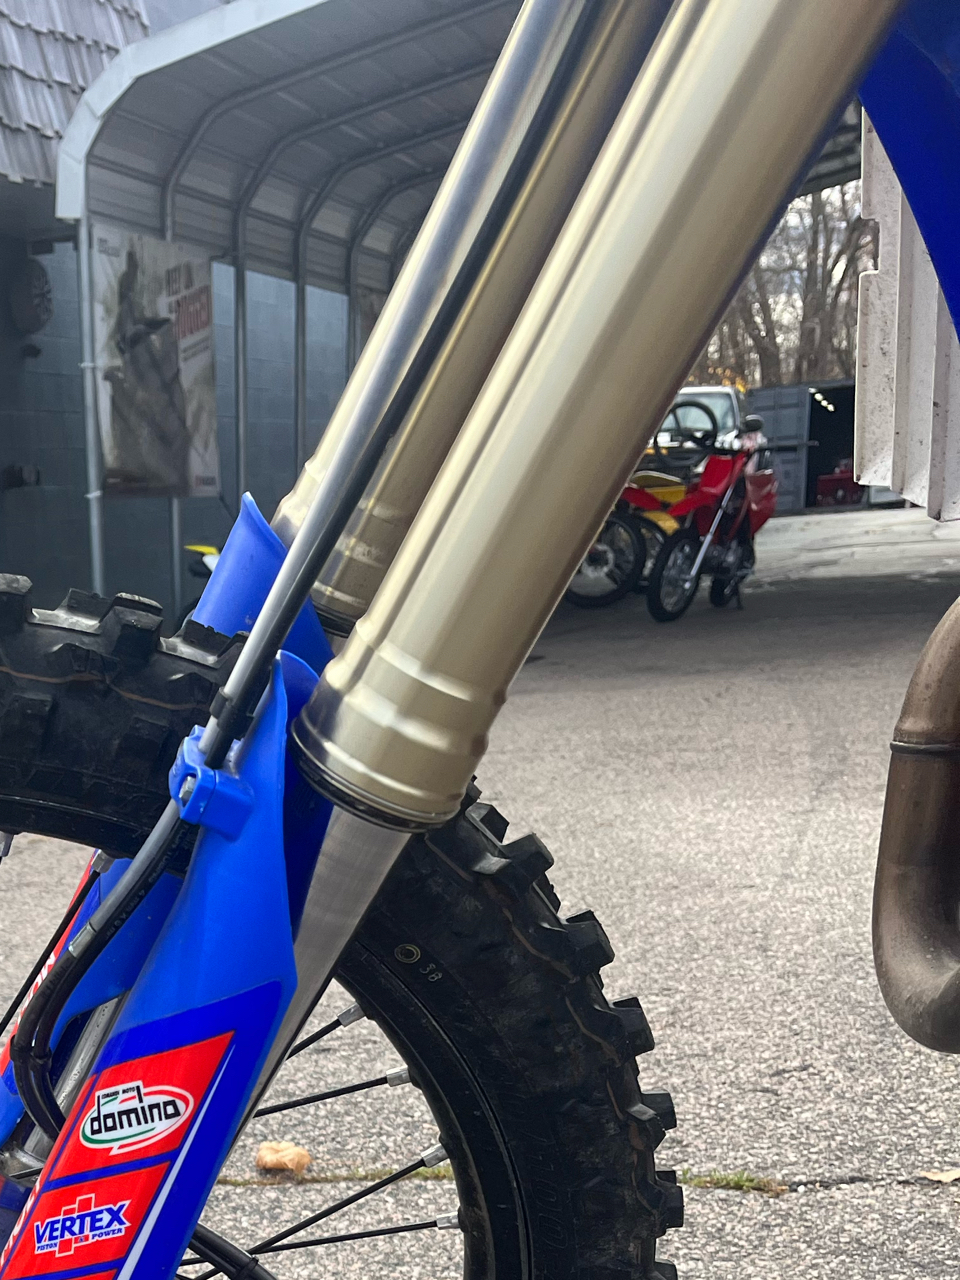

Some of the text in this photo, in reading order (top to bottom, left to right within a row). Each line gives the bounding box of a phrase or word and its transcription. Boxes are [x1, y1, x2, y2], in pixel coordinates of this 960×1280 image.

[90, 1085, 182, 1136] domino
[35, 1202, 128, 1245] VERTEX
[36, 1241, 58, 1252] PISTON
[91, 1227, 123, 1240] POWER
